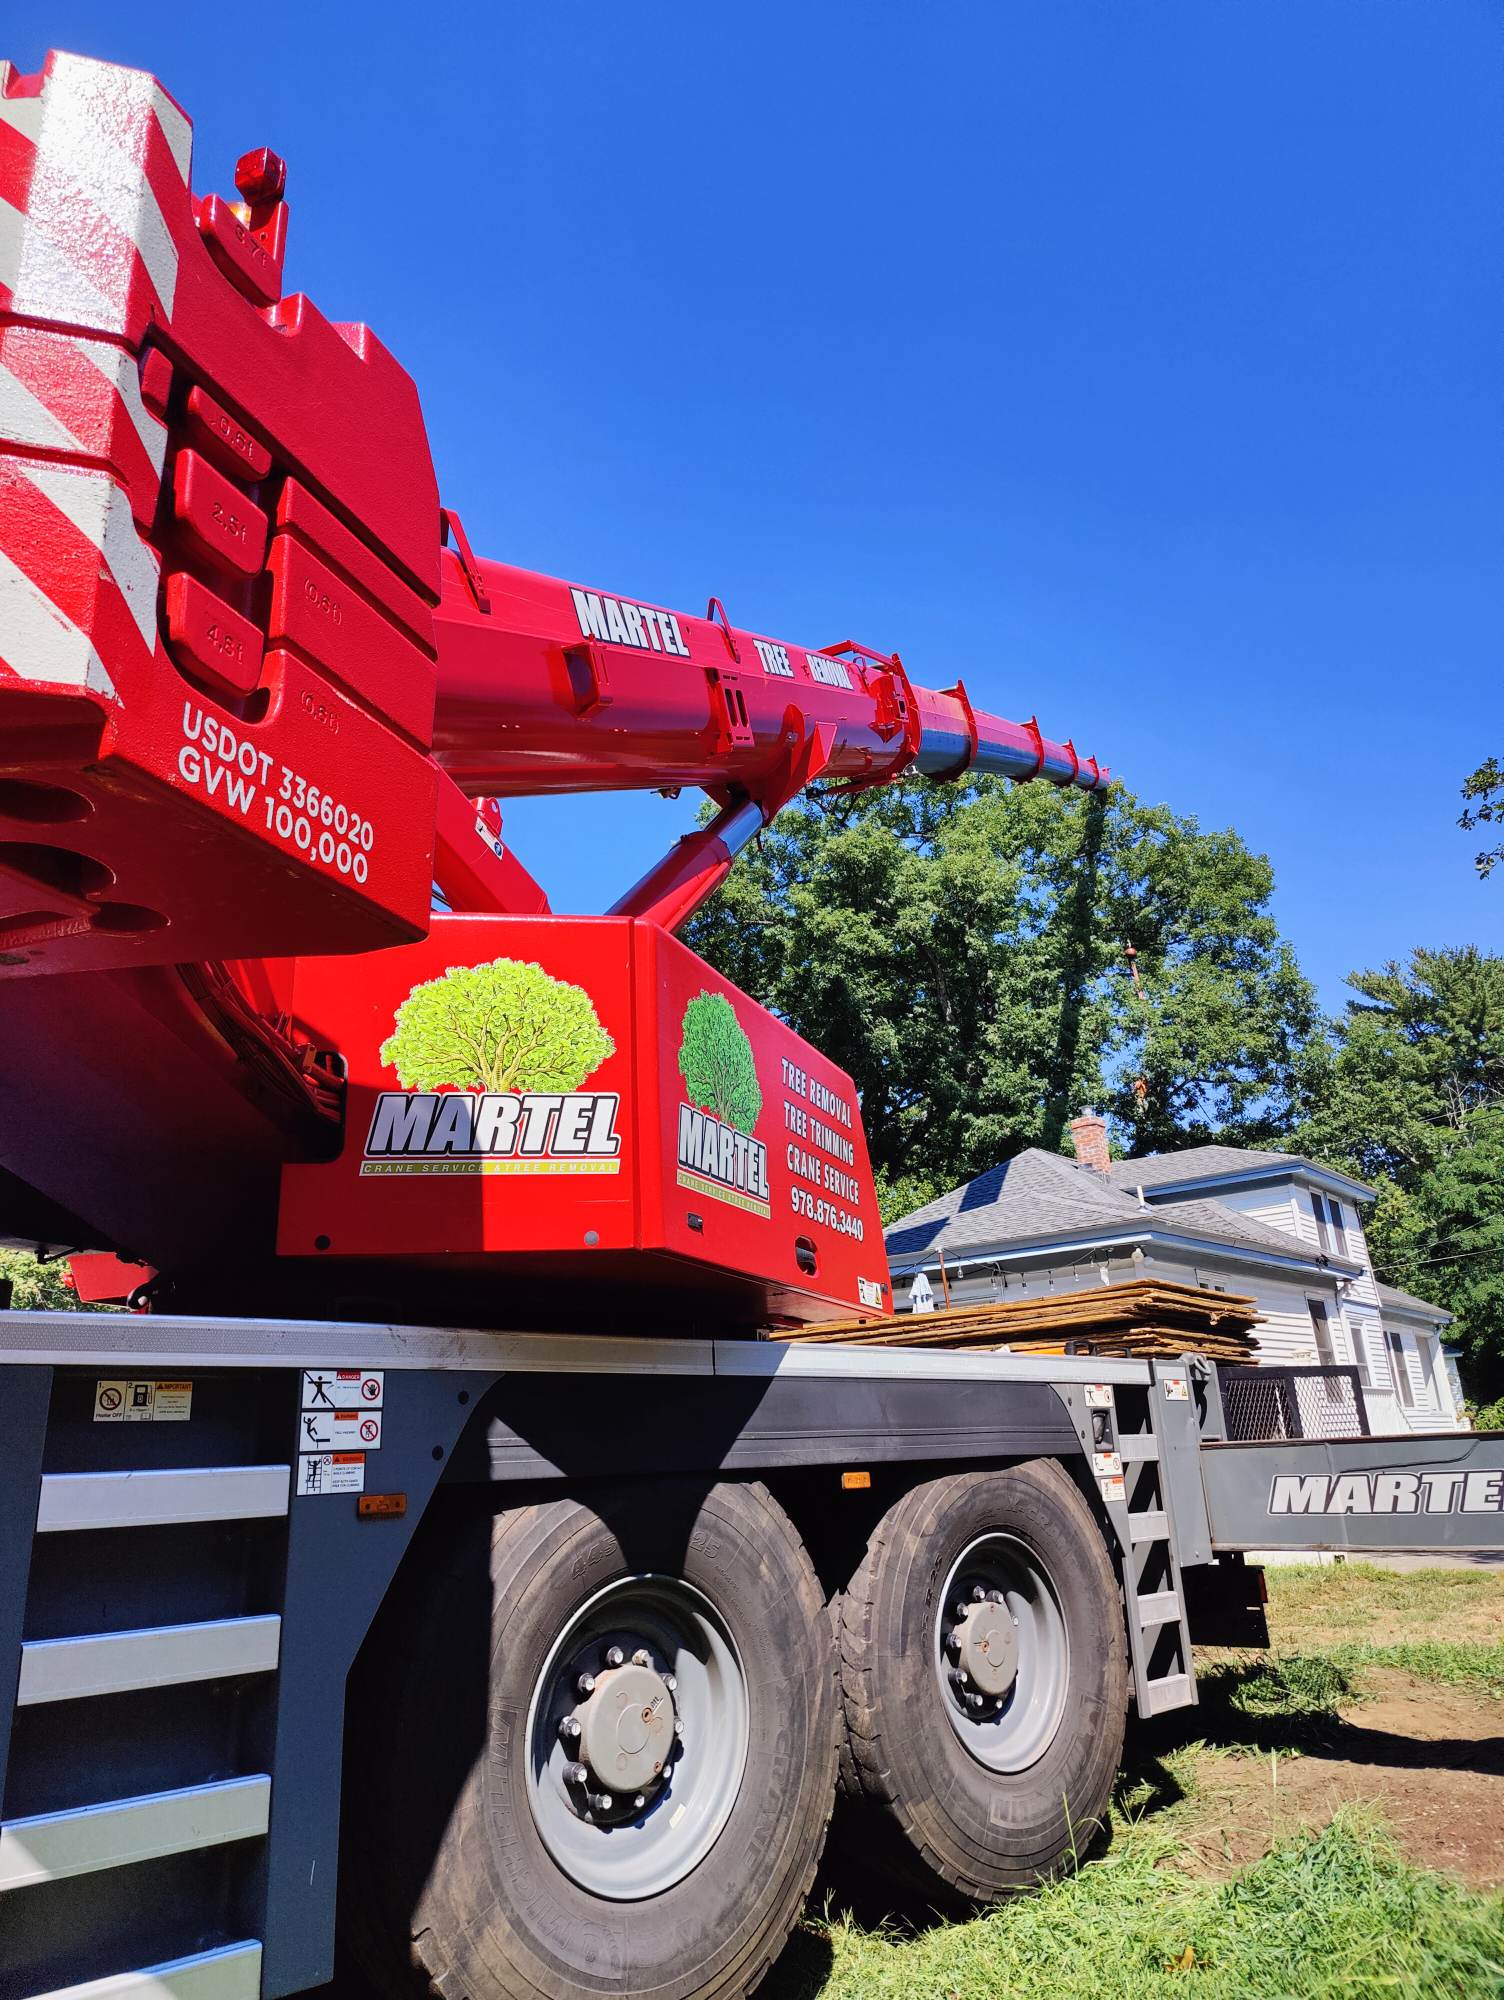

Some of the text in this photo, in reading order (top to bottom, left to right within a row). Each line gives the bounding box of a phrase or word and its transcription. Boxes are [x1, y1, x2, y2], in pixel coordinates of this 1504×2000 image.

[569, 586, 691, 658] MARTEL
[753, 639, 855, 691] TREE REMOVAL
[182, 701, 374, 852] USDOT 3366020
[178, 745, 369, 884] GVW 100,000
[366, 1094, 621, 1155] MARTEL
[781, 1056, 852, 1129] TREE REMOVAL
[678, 1103, 769, 1201] MARTEL
[783, 1099, 854, 1168] TREE TRIMMING
[363, 1163, 414, 1174] CRANE
[421, 1163, 485, 1173] SERVICE
[548, 1162, 617, 1172] REMOVAL
[787, 1142, 860, 1205] CRANE SERVICE
[791, 1184, 864, 1242] 978.876.3440
[1268, 1471, 1504, 1515] MARTE
